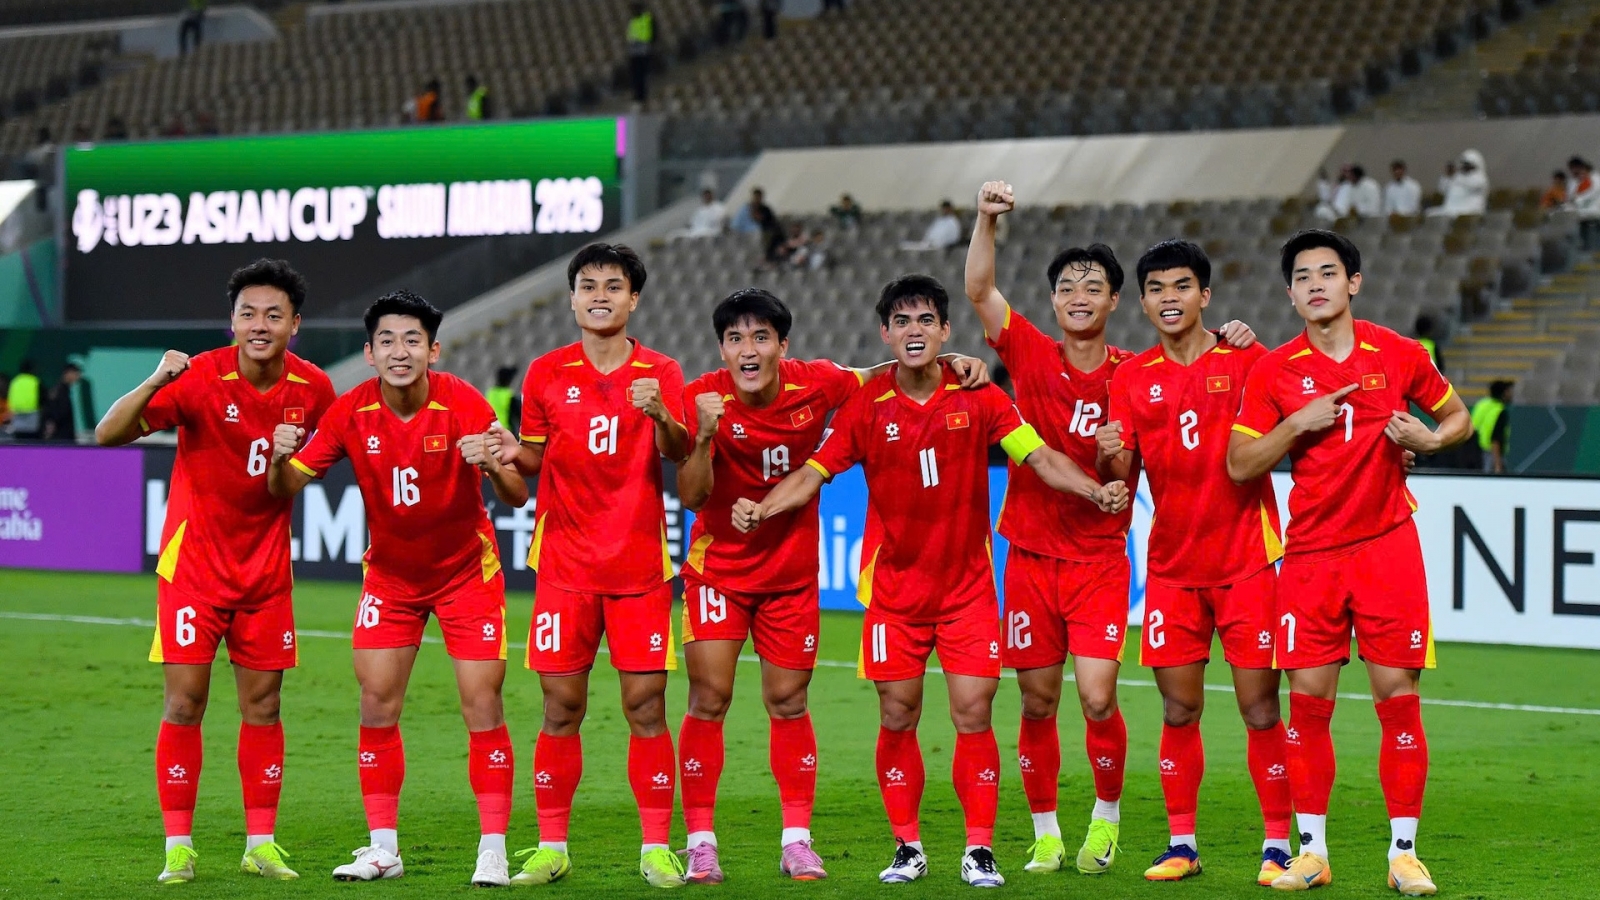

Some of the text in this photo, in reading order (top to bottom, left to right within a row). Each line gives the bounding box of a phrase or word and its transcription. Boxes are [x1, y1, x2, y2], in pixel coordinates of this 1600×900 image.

[118, 193, 182, 246] U23
[181, 189, 291, 244] ASIAN
[290, 186, 367, 242] CUP
[588, 414, 619, 456] 21
[1069, 399, 1102, 437] 12
[1180, 409, 1200, 451] 2
[247, 437, 269, 477] 6
[762, 444, 790, 482] 19
[919, 447, 940, 488] 11
[393, 466, 421, 507] 16
[356, 591, 383, 629] 16
[699, 584, 727, 624] 19
[175, 605, 197, 648] 6
[535, 611, 561, 652] 21
[872, 622, 888, 664] 11
[1007, 610, 1032, 650] 12
[1148, 608, 1166, 650] 2
[1281, 612, 1297, 653] 7
